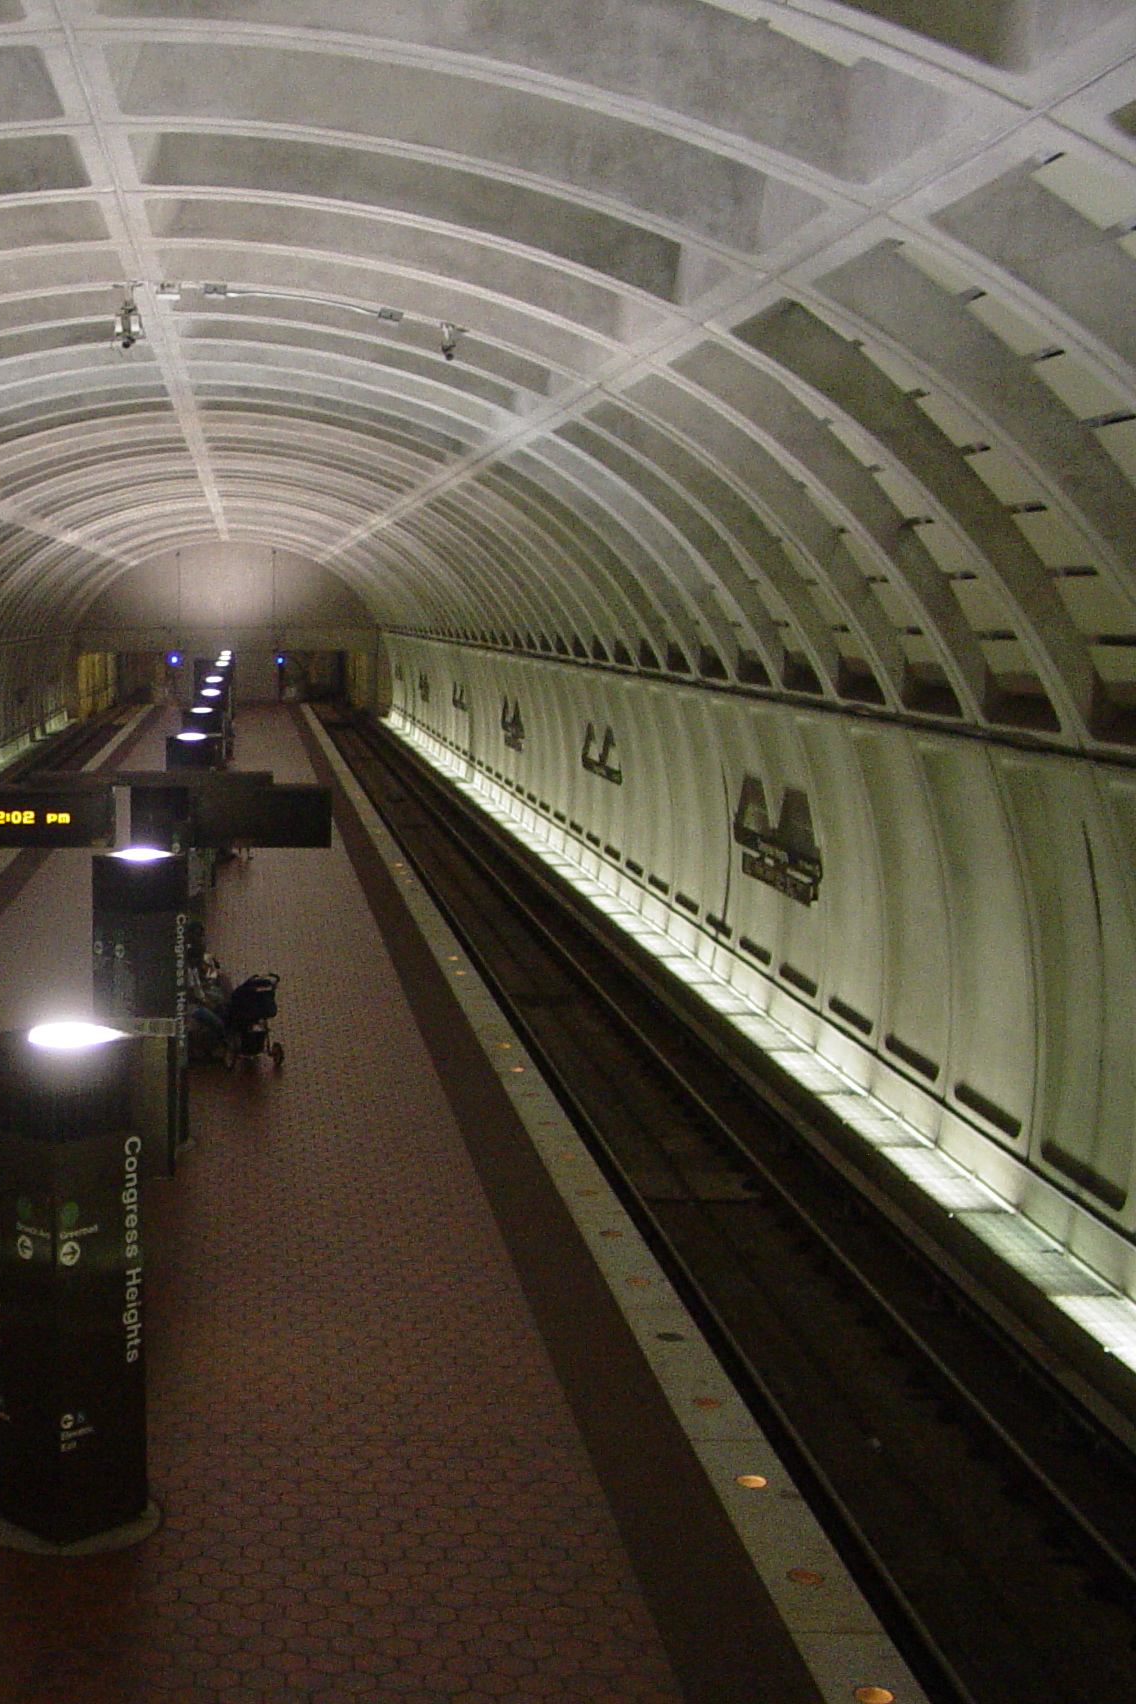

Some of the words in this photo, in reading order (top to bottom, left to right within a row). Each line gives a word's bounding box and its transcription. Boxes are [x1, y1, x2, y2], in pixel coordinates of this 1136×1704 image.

[174, 913, 187, 987] Congress
[121, 1135, 142, 1259] Congress
[122, 1267, 142, 1364] Heights
